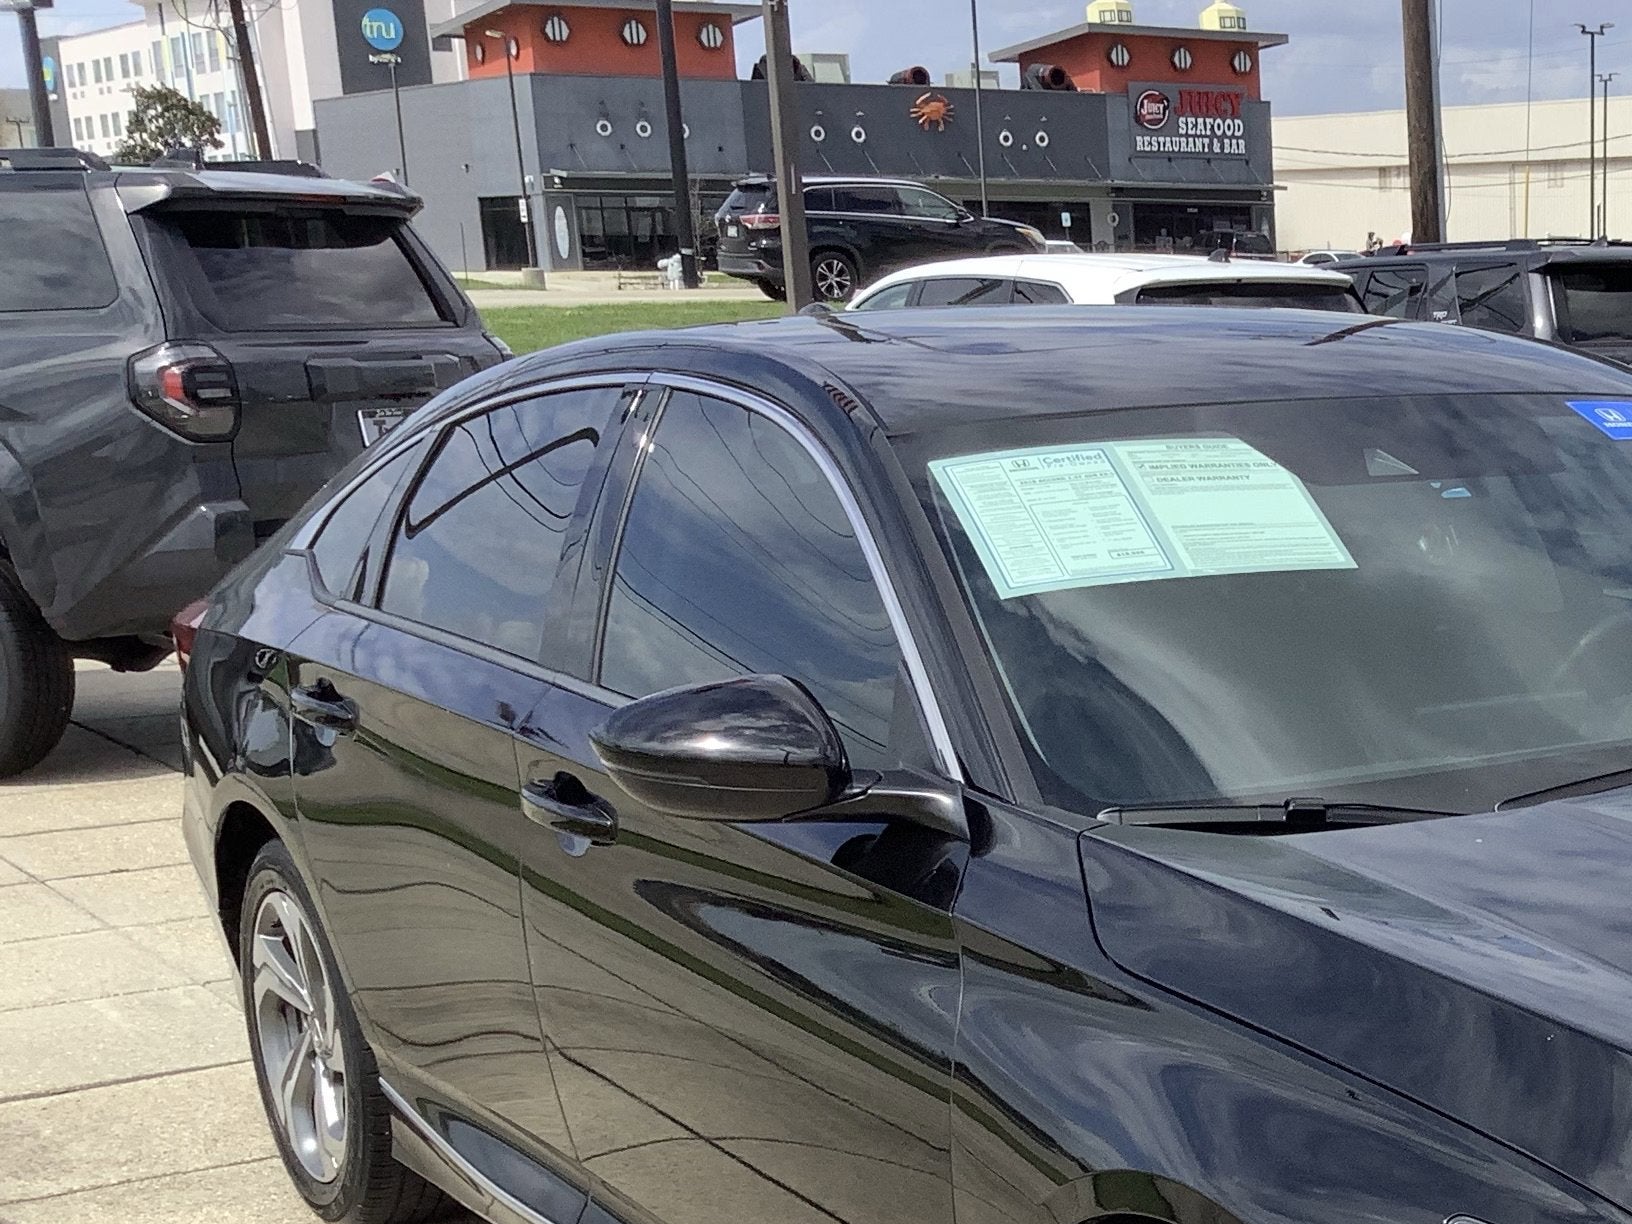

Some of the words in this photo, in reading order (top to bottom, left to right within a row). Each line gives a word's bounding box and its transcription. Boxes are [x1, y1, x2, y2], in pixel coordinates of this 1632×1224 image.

[361, 16, 396, 39] tru
[1174, 89, 1242, 116] JUICY
[1178, 117, 1244, 136] SEAFOOD
[1136, 136, 1210, 153] RESTAURANT
[1212, 138, 1221, 153] &
[1224, 138, 1246, 154] BAR
[1042, 452, 1102, 465] Certified
[1148, 463, 1187, 471] IMPLIED
[1190, 462, 1250, 470] WARRANTIES
